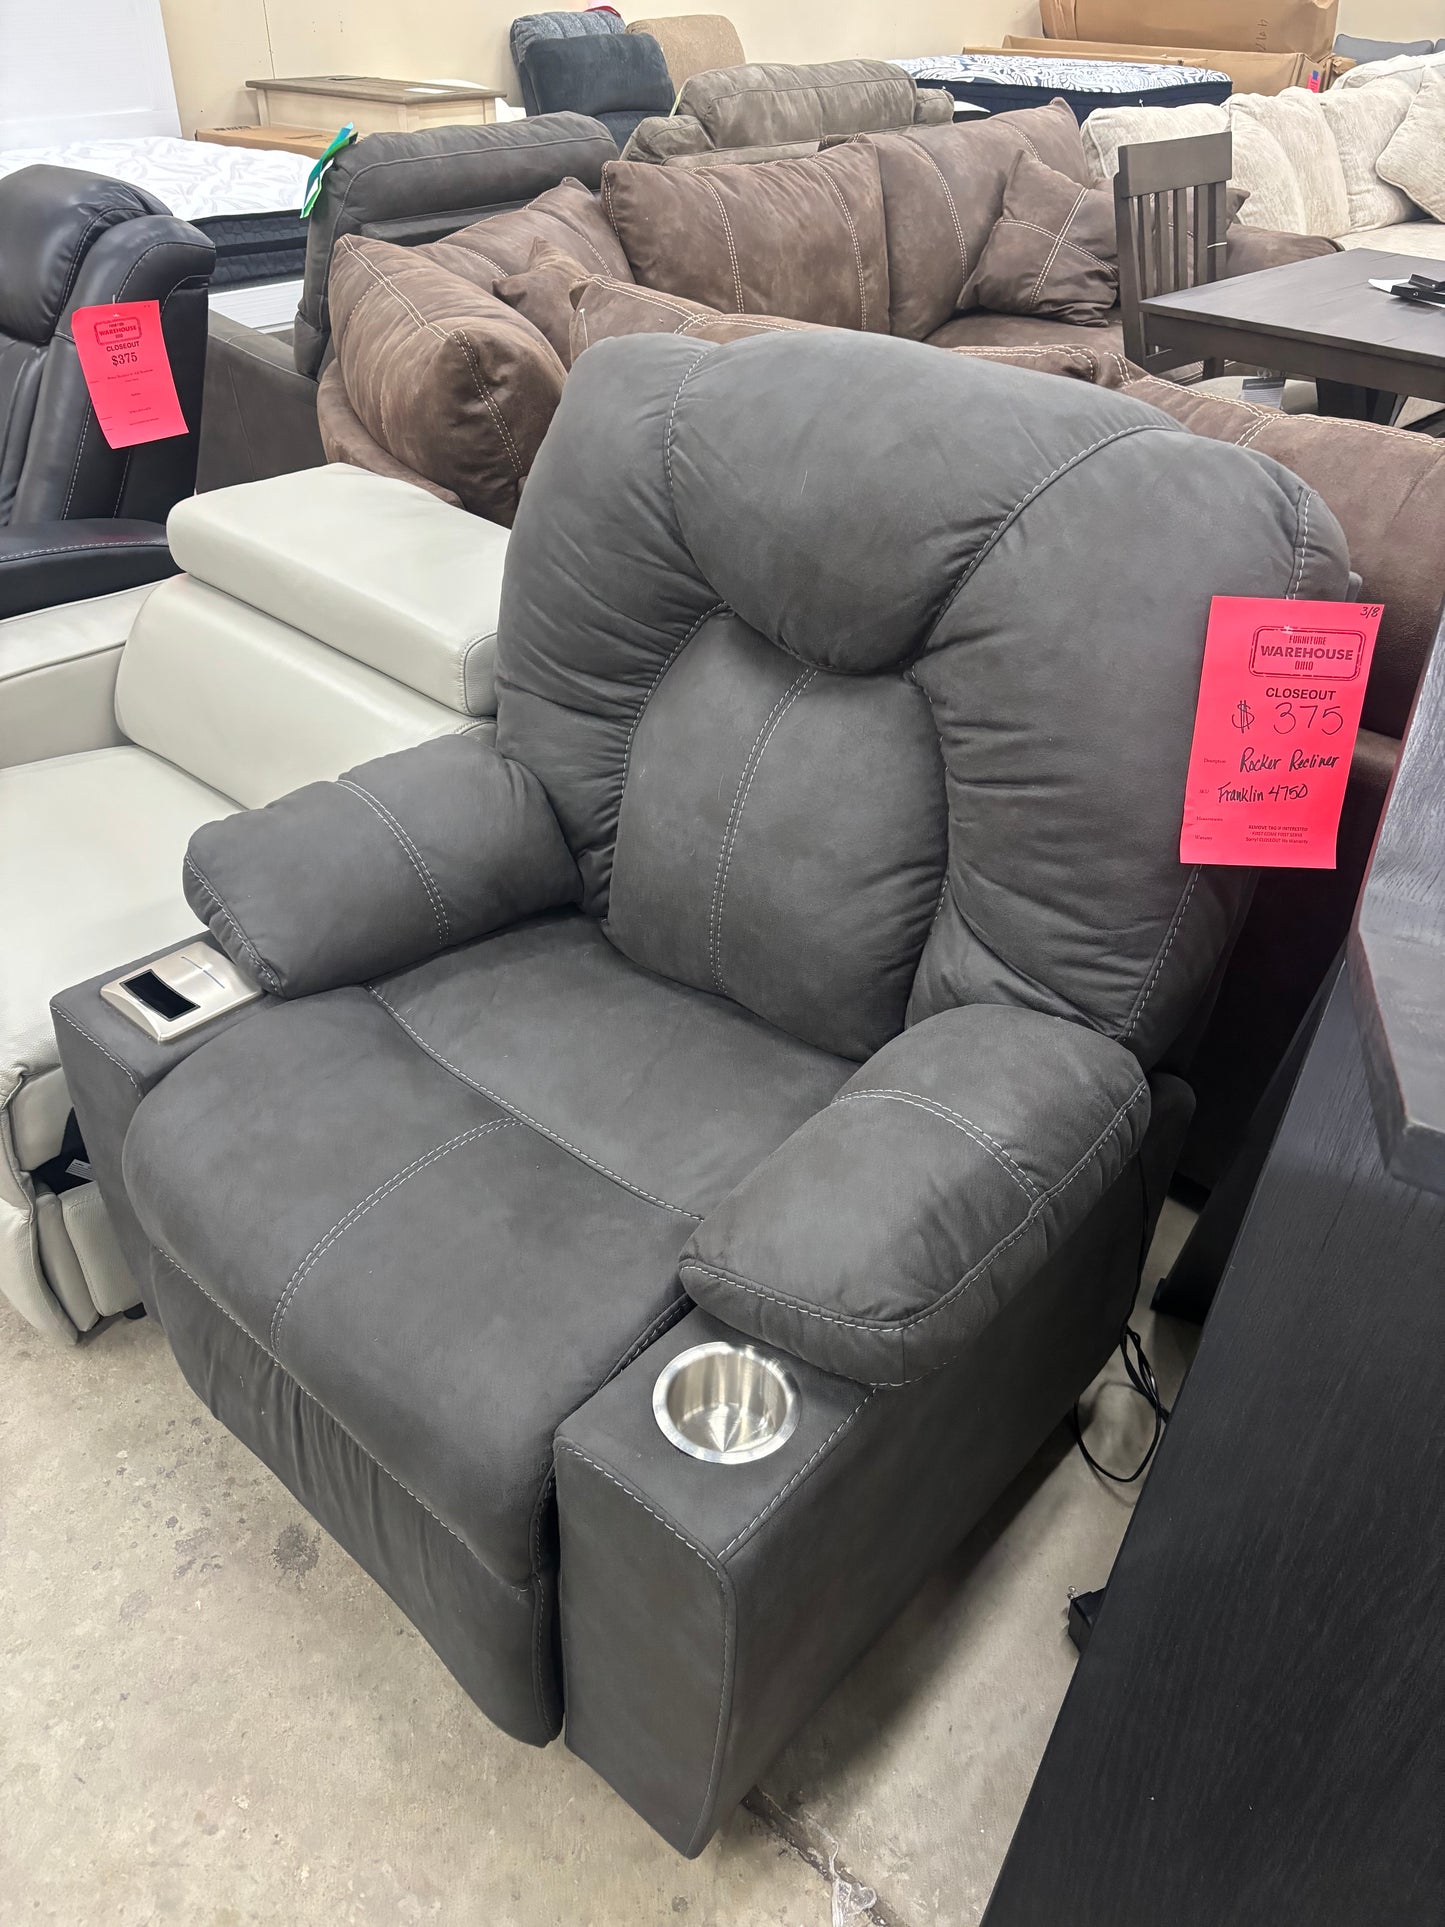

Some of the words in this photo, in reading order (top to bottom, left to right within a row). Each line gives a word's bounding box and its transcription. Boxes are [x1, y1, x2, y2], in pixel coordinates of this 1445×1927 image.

[99, 325, 137, 336] WAREHOUSE
[106, 341, 140, 352] CLOSEOUT
[111, 352, 138, 367] $375
[1360, 606, 1381, 619] 3/8
[1289, 635, 1327, 645] FURNITURE
[1260, 645, 1354, 660] WAREHOUSE
[1294, 660, 1314, 671] OHIO
[1265, 687, 1336, 700] CLOSEOUT
[1231, 700, 1255, 734] $
[1273, 701, 1344, 736] 375
[1239, 746, 1282, 773] Rocker
[1288, 748, 1340, 772] Recliner
[1217, 781, 1264, 803] Franklin
[1268, 783, 1309, 802] 4750
